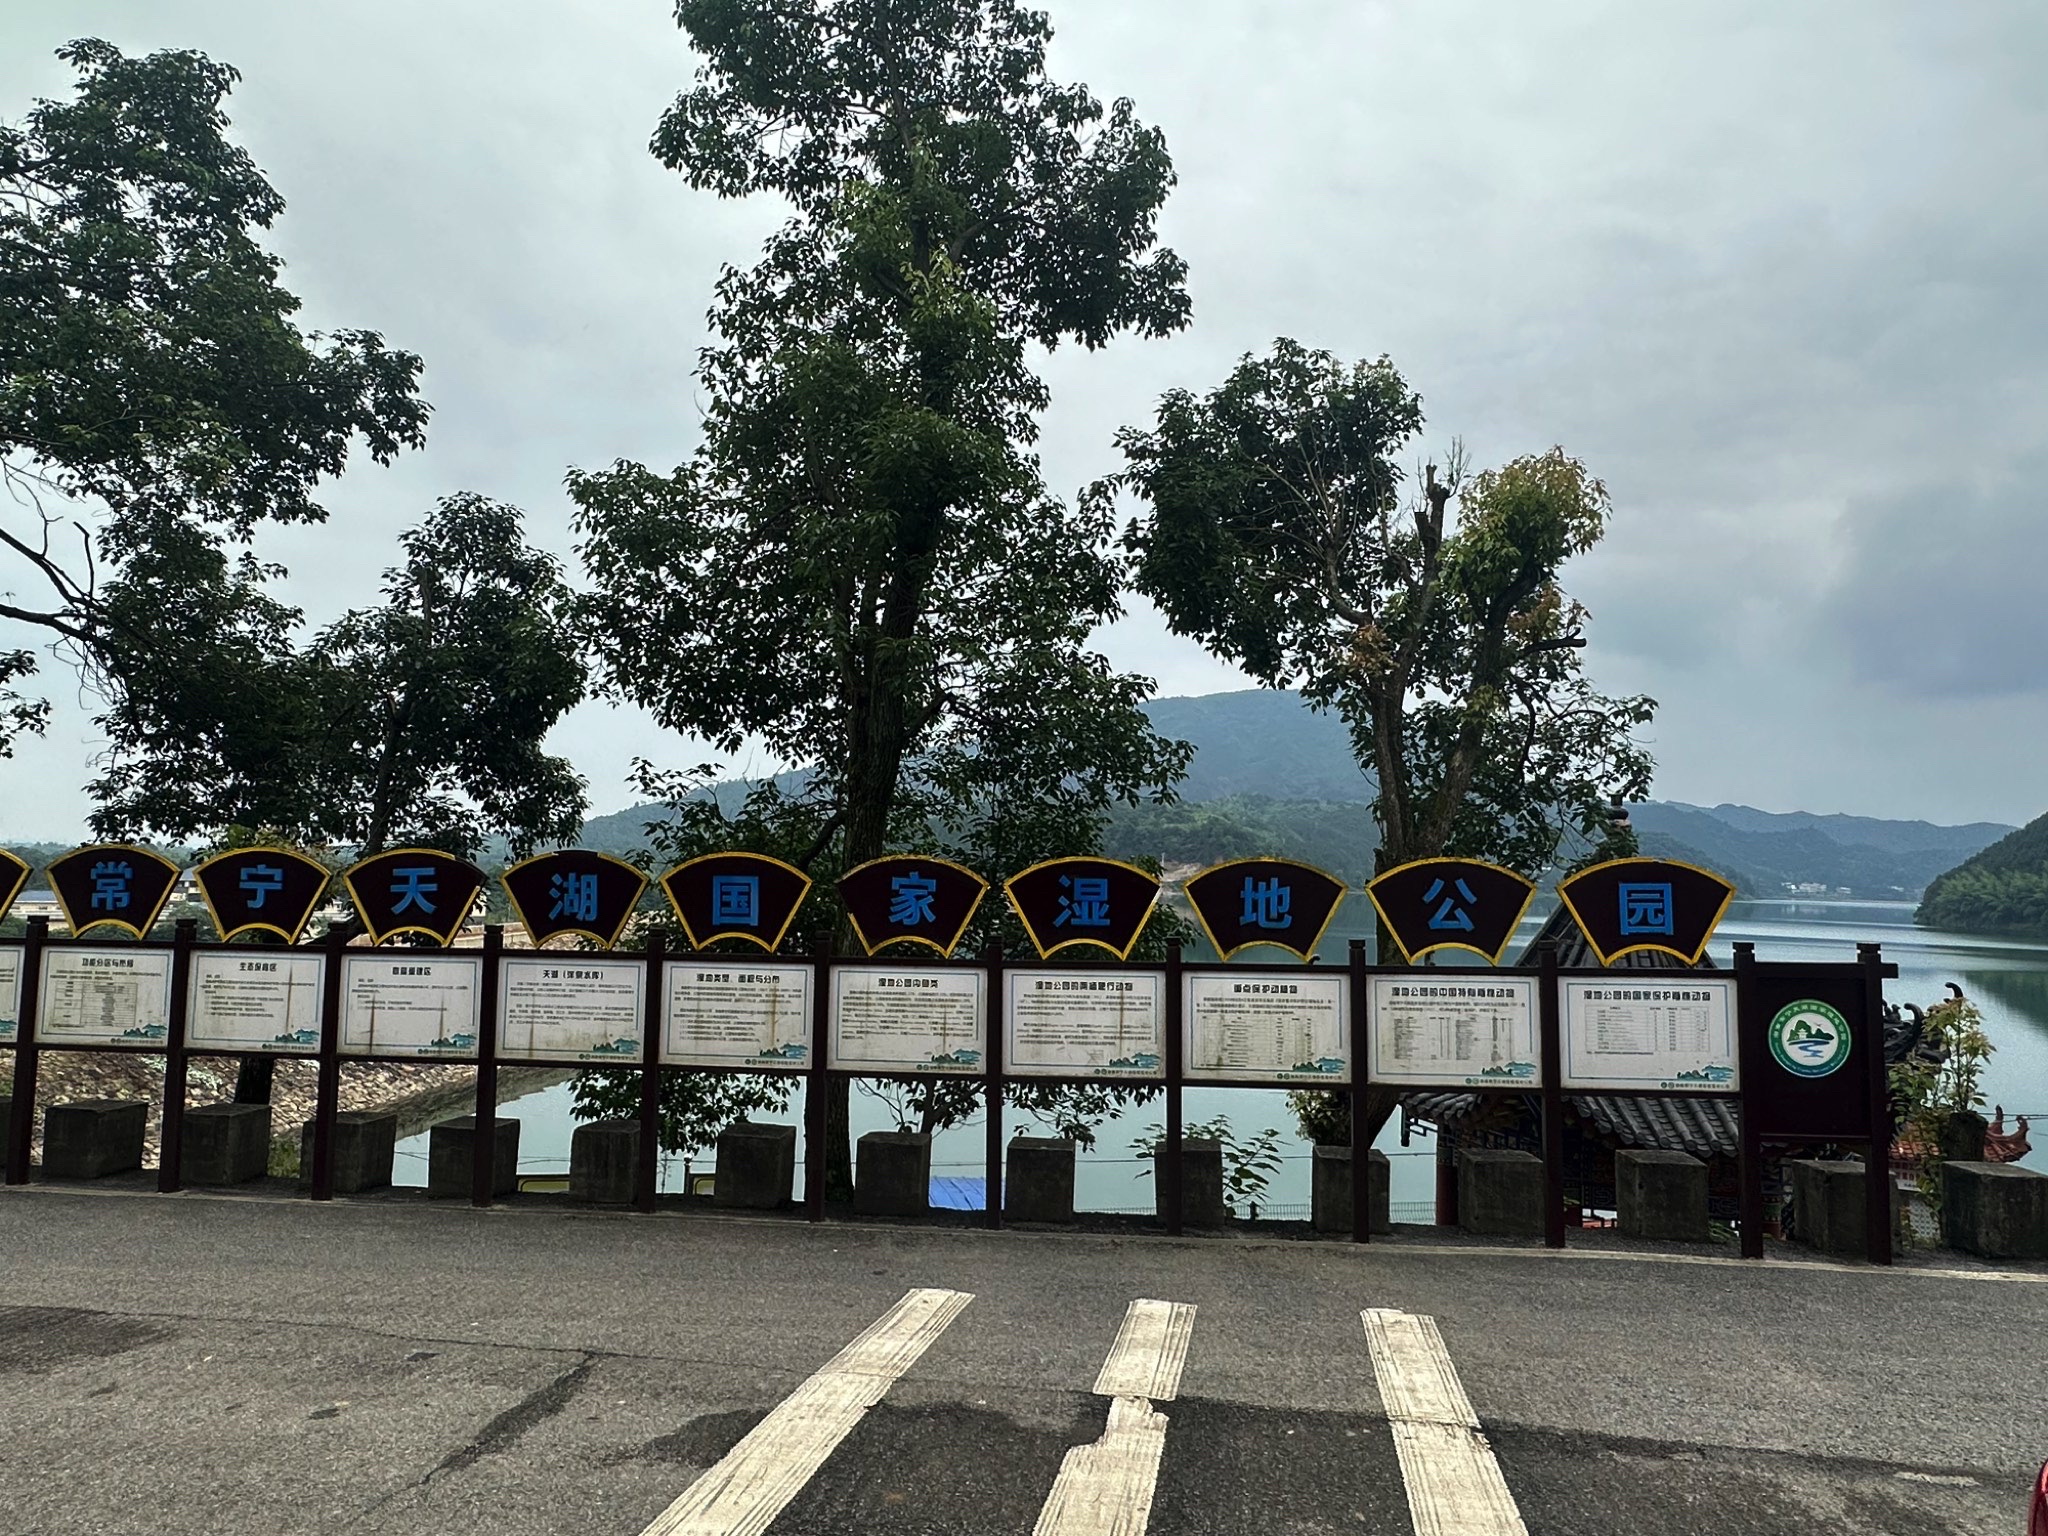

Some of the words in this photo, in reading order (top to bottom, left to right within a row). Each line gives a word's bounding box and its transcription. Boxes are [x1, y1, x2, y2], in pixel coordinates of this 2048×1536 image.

[90, 861, 133, 910] 常
[239, 864, 283, 908] 宁
[390, 867, 437, 914] 天
[548, 872, 597, 921] 湖
[712, 875, 758, 926] 国
[889, 872, 937, 925] 家
[1053, 874, 1110, 927] 湿
[1239, 876, 1291, 929] 地
[1422, 877, 1477, 931] 公
[1619, 882, 1674, 935] 园
